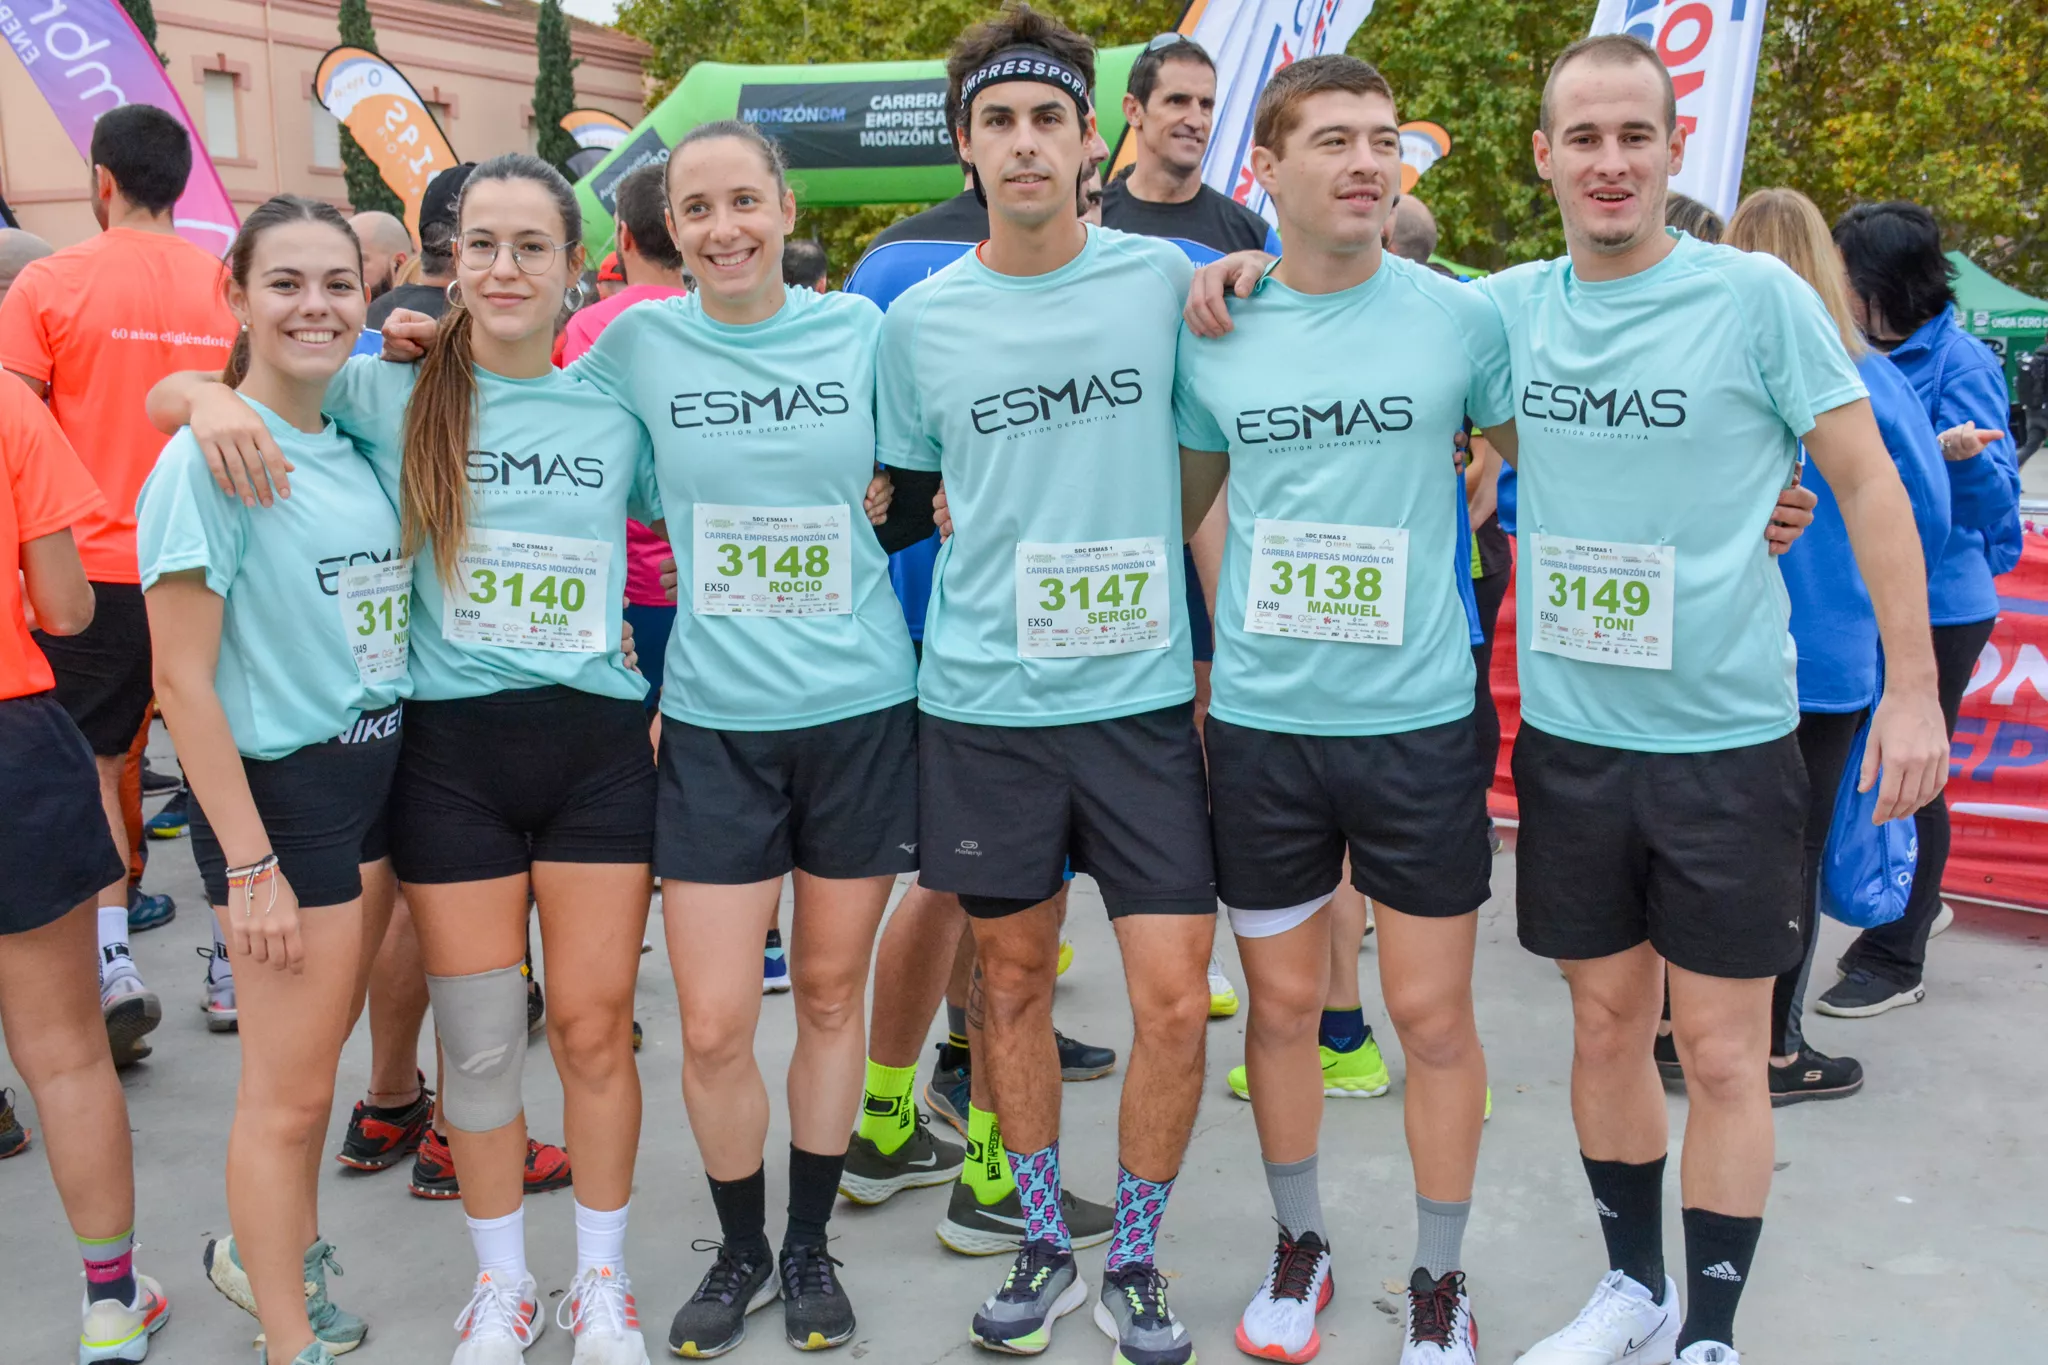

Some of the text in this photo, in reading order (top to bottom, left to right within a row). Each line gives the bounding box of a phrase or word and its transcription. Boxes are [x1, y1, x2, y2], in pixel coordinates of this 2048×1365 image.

[865, 110, 947, 128] EMPRESA
[860, 130, 935, 147] MONZÓN
[111, 328, 128, 339] 60
[670, 381, 850, 429] ESMAS
[970, 368, 1143, 435] ESMAS
[1522, 380, 1688, 429] ESMAS
[758, 423, 825, 434] DEPORTIVA
[1057, 414, 1117, 429] DEPORTIVA
[1236, 396, 1413, 445] ESMAS
[1319, 439, 1382, 449] DEPORTIVA
[1590, 431, 1649, 441] DEPORTIVA
[465, 450, 604, 489] SMAS
[704, 532, 840, 543] CARRERA EMPRESAS MONZÓN CM
[527, 543, 549, 551] ESMAS
[717, 543, 830, 579] 3148
[1261, 547, 1394, 564] CARRERA EMPRESAS MONZÓN CM
[459, 556, 597, 576] CARRERA EMPRESAS MONZÓN CM
[1026, 560, 1156, 574] CARRERA EMPRESAS MONZÓN CM
[1540, 558, 1661, 578] CARRERA EMPRESAS MONZÓN CM
[704, 583, 730, 592] EX50
[769, 580, 823, 593] ROCIO
[1269, 560, 1382, 602] 3138
[347, 586, 376, 599] CARRERA
[469, 569, 586, 612] 3140
[1039, 572, 1149, 611] 3147
[1548, 572, 1650, 617] 3149
[1256, 600, 1280, 611] EX49
[1307, 601, 1382, 617] MANUEL
[356, 593, 409, 636] 313
[454, 608, 481, 620] EX49
[530, 611, 569, 626] LAIA
[1087, 608, 1147, 624] SERGIO
[1540, 611, 1559, 623] EX50
[1027, 618, 1053, 627] EX50
[1592, 616, 1634, 632] TONI
[1702, 1269, 1742, 1282] adidas
